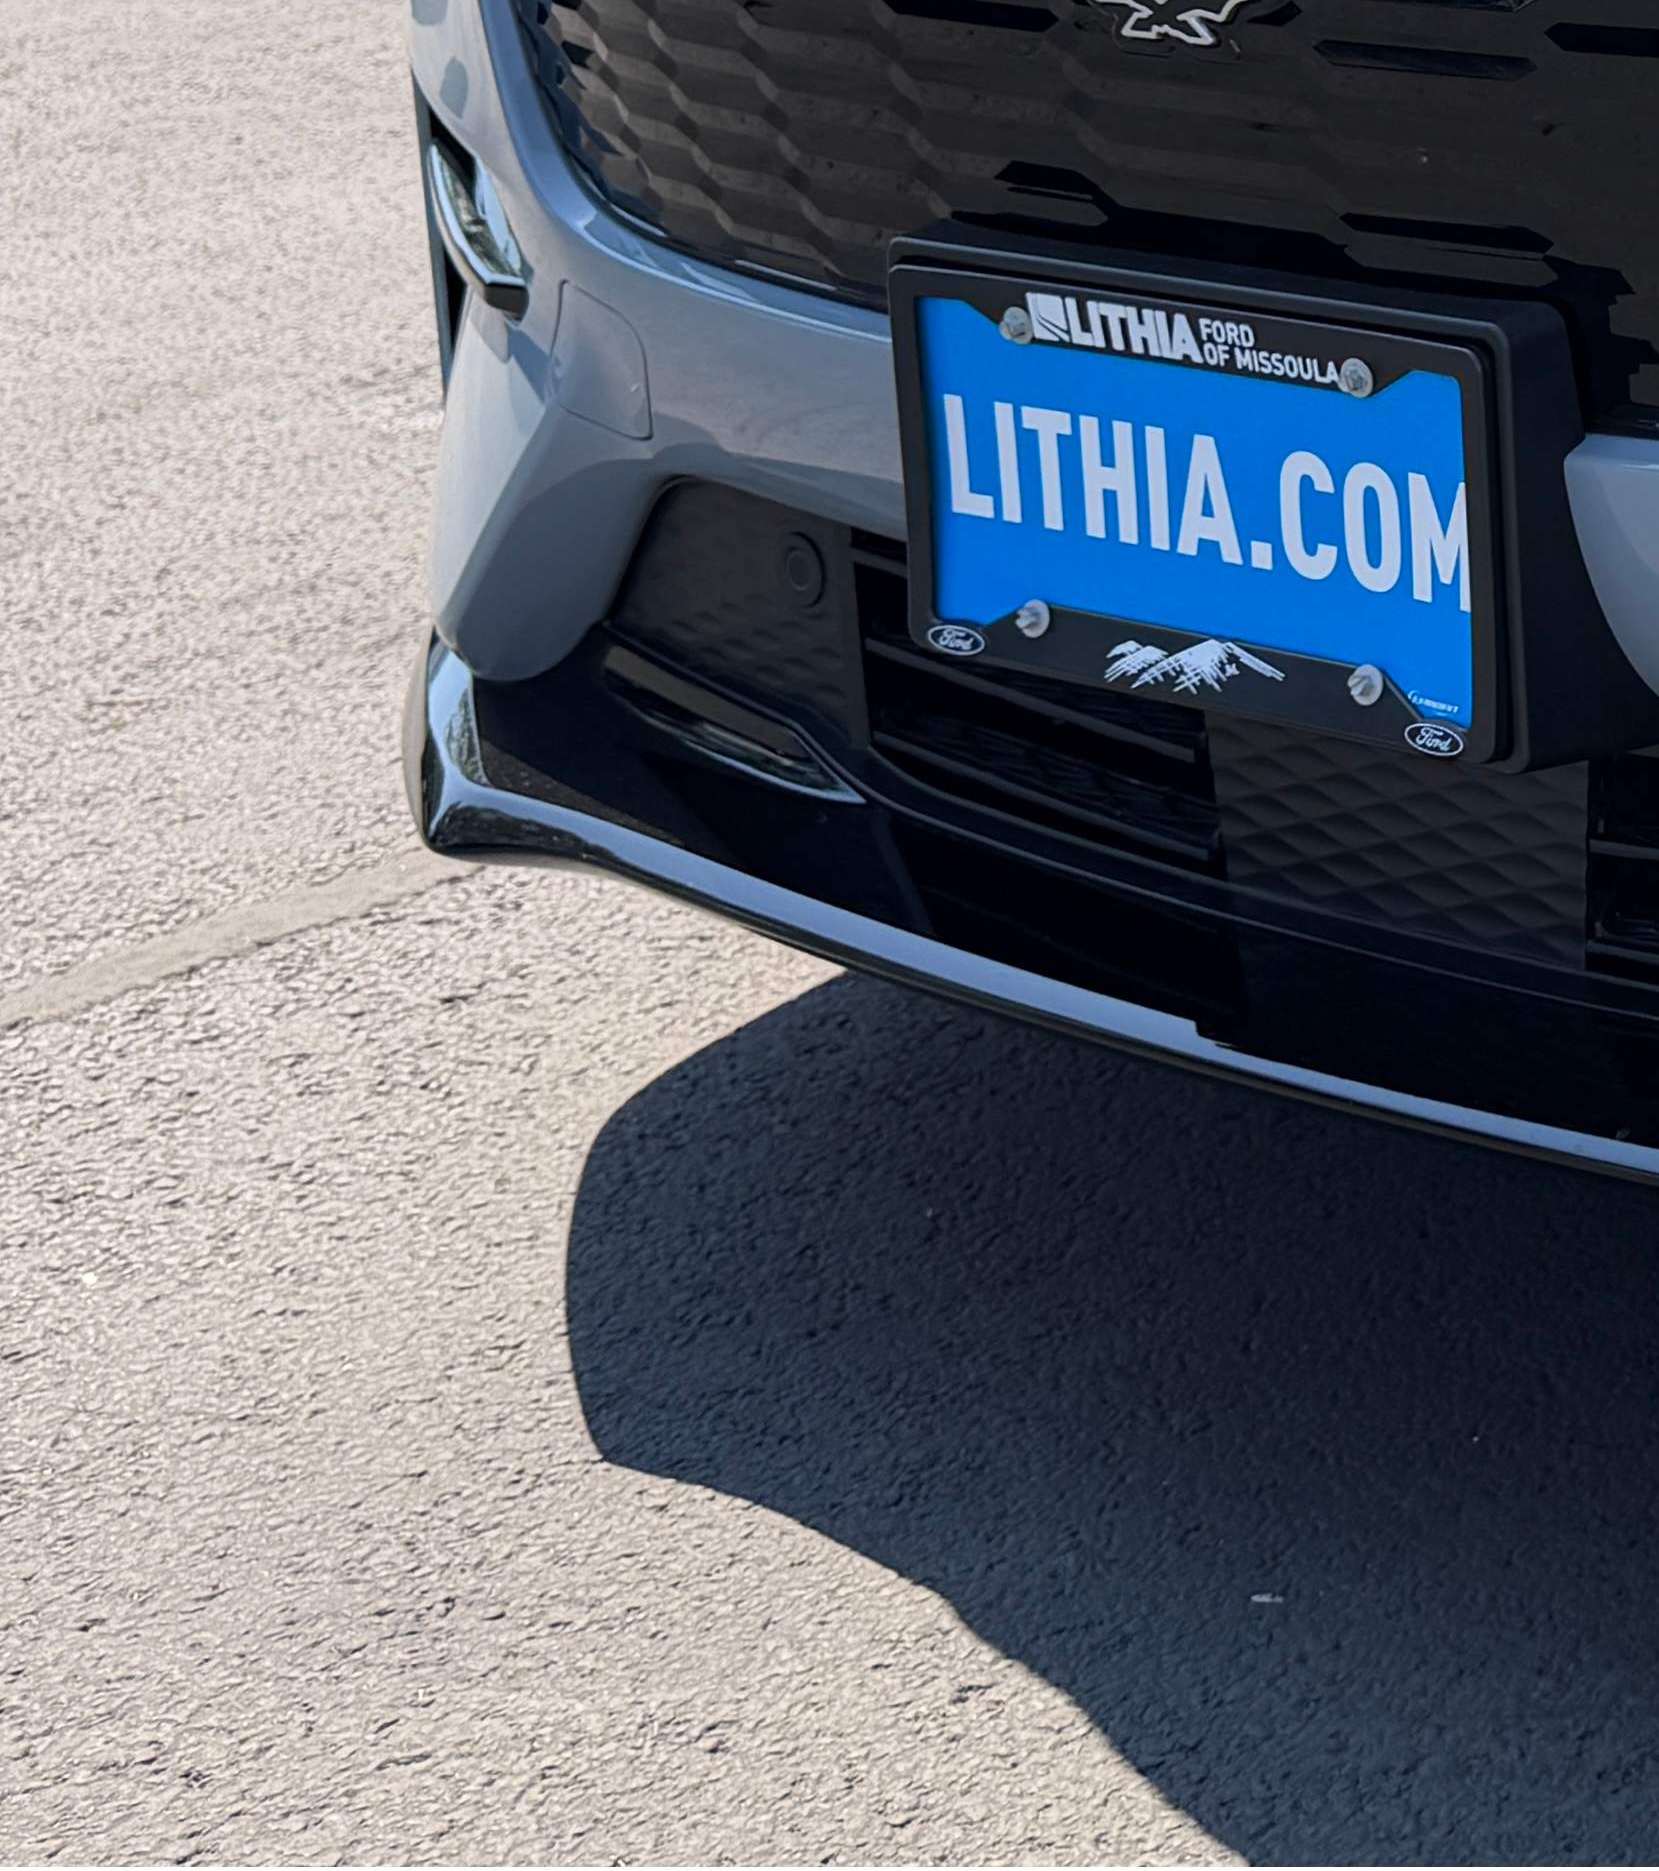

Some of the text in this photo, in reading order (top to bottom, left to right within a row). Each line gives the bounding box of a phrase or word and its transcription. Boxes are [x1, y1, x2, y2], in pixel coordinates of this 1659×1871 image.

[1065, 296, 1204, 364] LITHIA
[1198, 318, 1256, 348] FORD
[1203, 342, 1340, 385] OF MISSOULA
[943, 394, 1473, 614] LITHIA.COM
[939, 628, 975, 650] Ford
[1415, 727, 1453, 751] Ford
